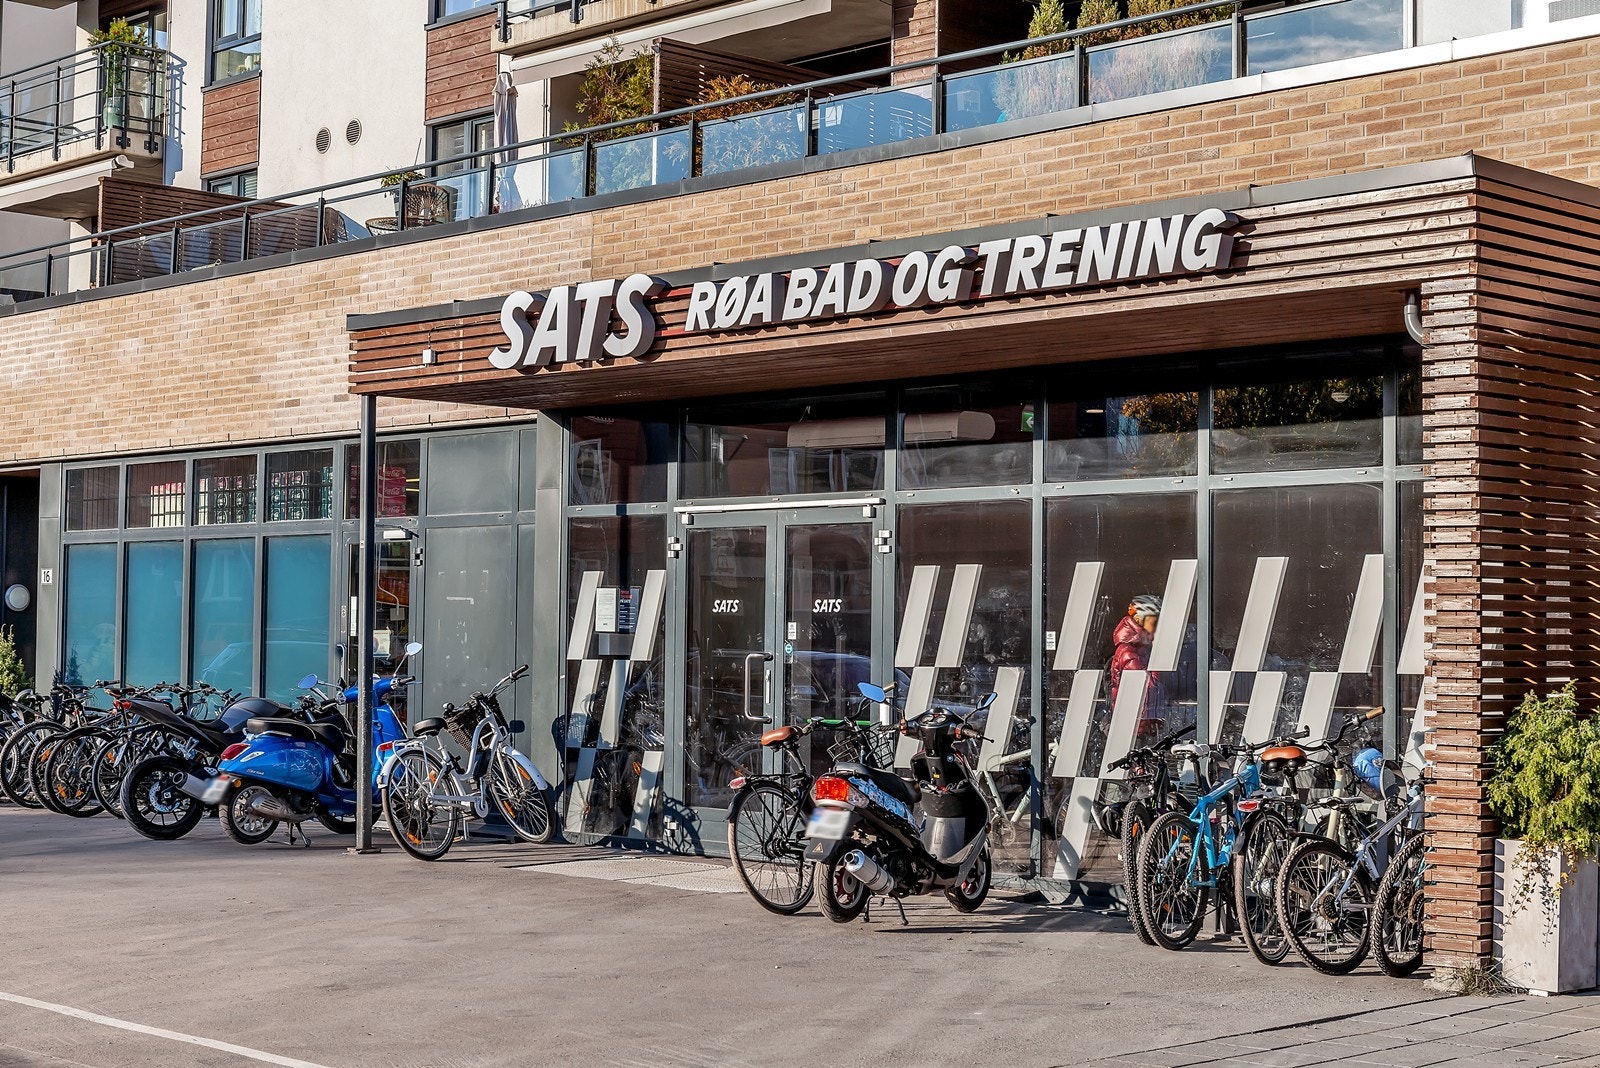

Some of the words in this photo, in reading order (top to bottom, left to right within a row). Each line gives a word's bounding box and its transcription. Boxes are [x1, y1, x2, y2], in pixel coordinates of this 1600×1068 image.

[487, 273, 656, 370] SATS
[685, 273, 774, 332] RØA
[782, 258, 885, 321] BAD
[892, 245, 967, 307] OG
[977, 208, 1228, 296] TRENING
[43, 570, 51, 583] 16
[712, 599, 740, 613] SATS
[812, 598, 842, 613] SATS
